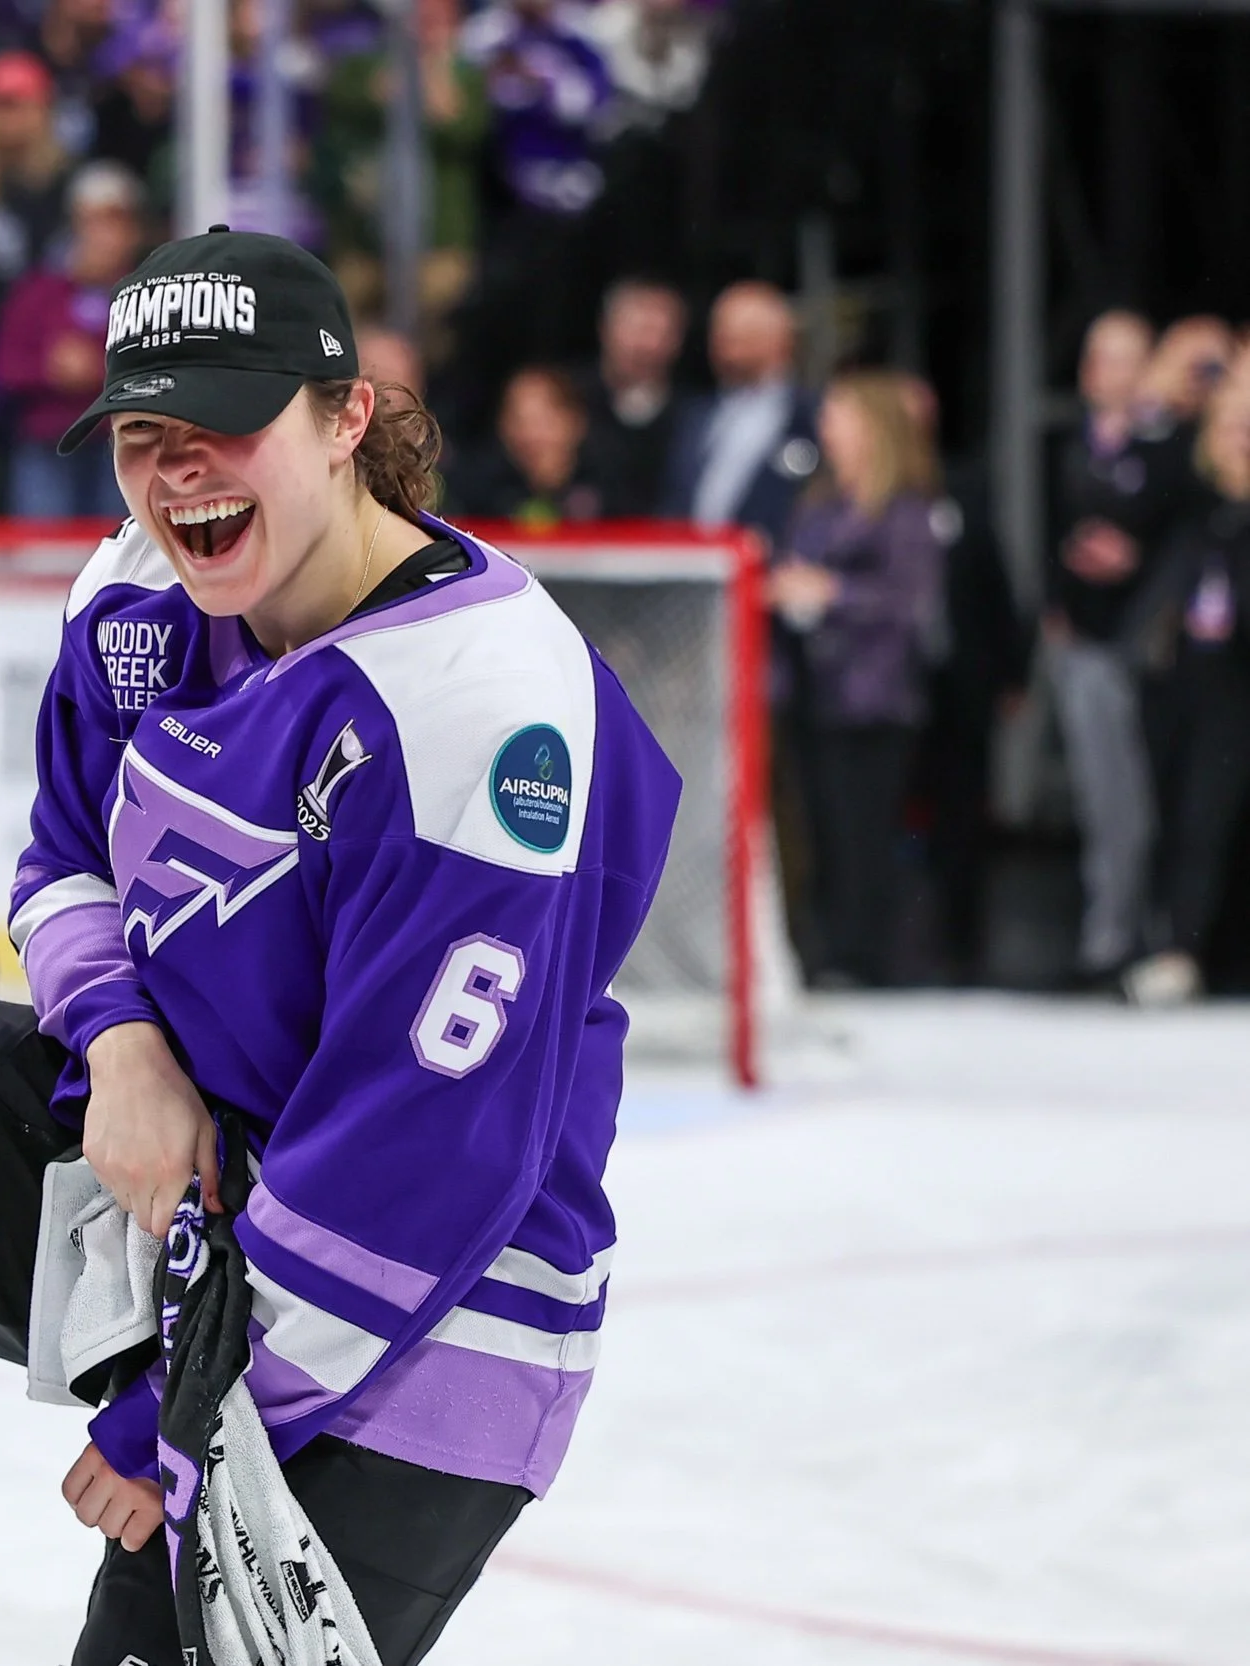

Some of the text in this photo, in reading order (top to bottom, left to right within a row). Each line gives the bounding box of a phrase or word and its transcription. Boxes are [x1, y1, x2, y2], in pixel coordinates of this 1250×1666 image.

[147, 272, 205, 286] WALTER
[208, 272, 242, 283] CUP
[105, 280, 257, 351] CHAMPIONS
[142, 331, 181, 349] 2025
[97, 621, 173, 656] WOODY
[102, 655, 168, 689] REEK
[158, 716, 222, 759] BAUER
[499, 777, 569, 807] AIRSUPRA
[409, 931, 526, 1080] 6
